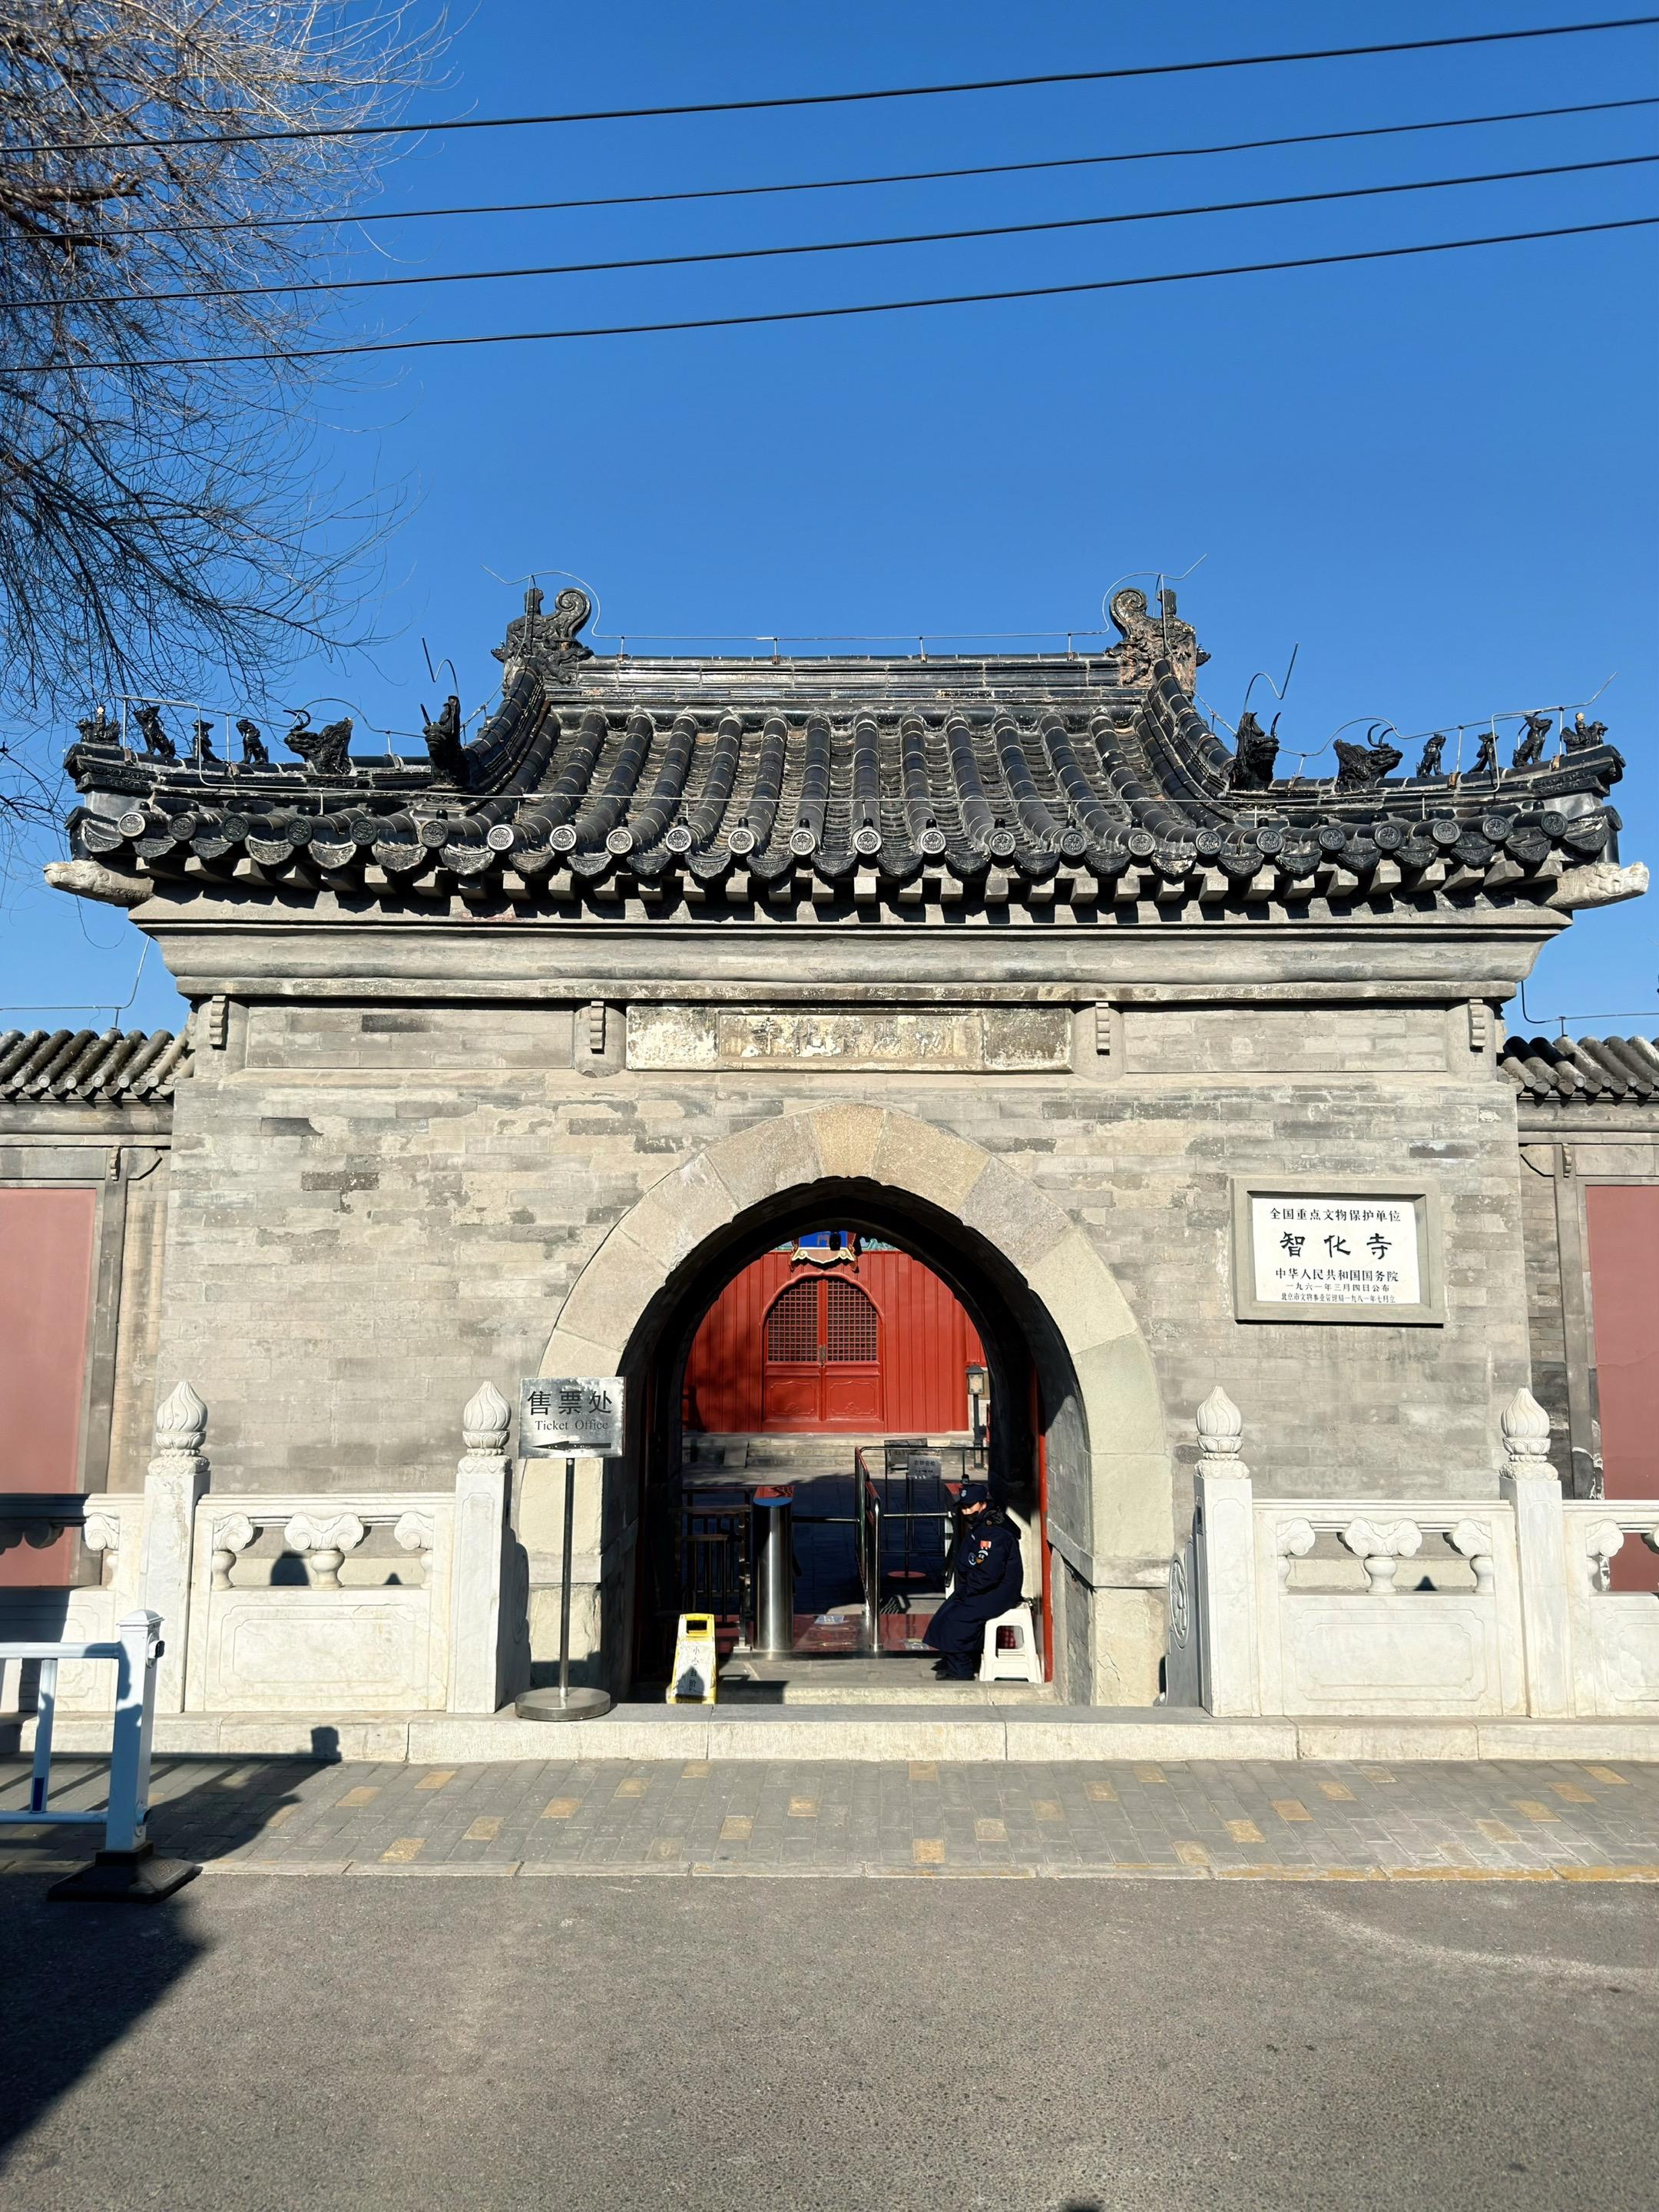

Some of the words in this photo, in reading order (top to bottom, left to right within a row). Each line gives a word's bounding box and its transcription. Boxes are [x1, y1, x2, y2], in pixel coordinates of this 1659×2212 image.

[1270, 1207, 1401, 1222] 全国重点文物保护单位
[1280, 1231, 1392, 1260] 智化寺
[1276, 1267, 1399, 1282] 中华人民共和国国务院
[1285, 1281, 1390, 1293] 一九六一年三月四日公布
[1281, 1292, 1396, 1303] 北京市文物事业管理局一九八一年七月立
[527, 1390, 612, 1416] 售票处
[535, 1420, 568, 1430] Ticket
[575, 1419, 608, 1430] Office
